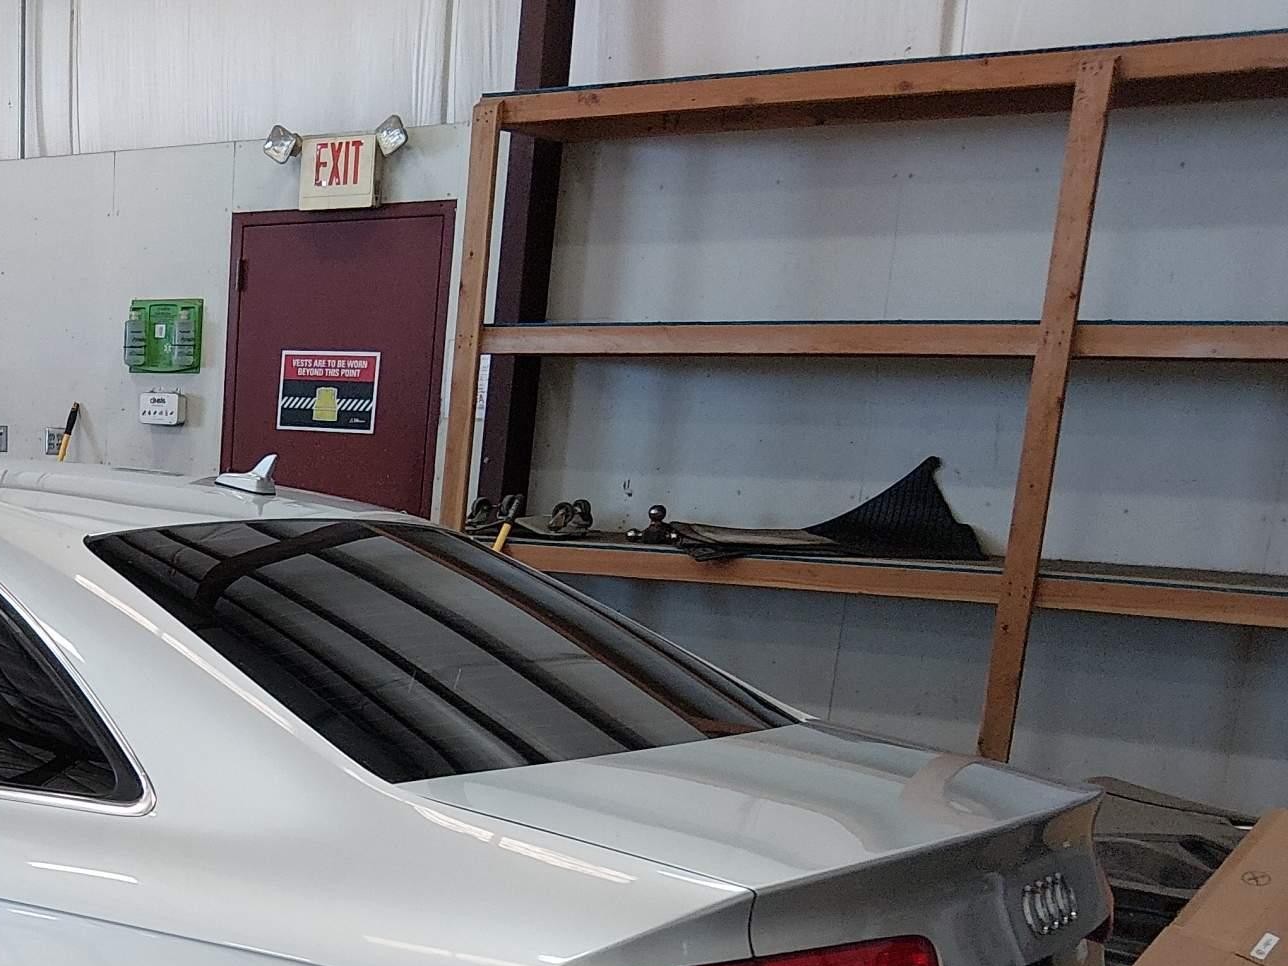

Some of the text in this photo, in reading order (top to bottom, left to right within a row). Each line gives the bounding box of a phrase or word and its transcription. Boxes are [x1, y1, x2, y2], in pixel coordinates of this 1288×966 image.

[313, 140, 364, 187] EXIT
[292, 359, 368, 369] VESTS ARE TO BE WORN
[297, 368, 360, 377] BEYOND THIS POINT
